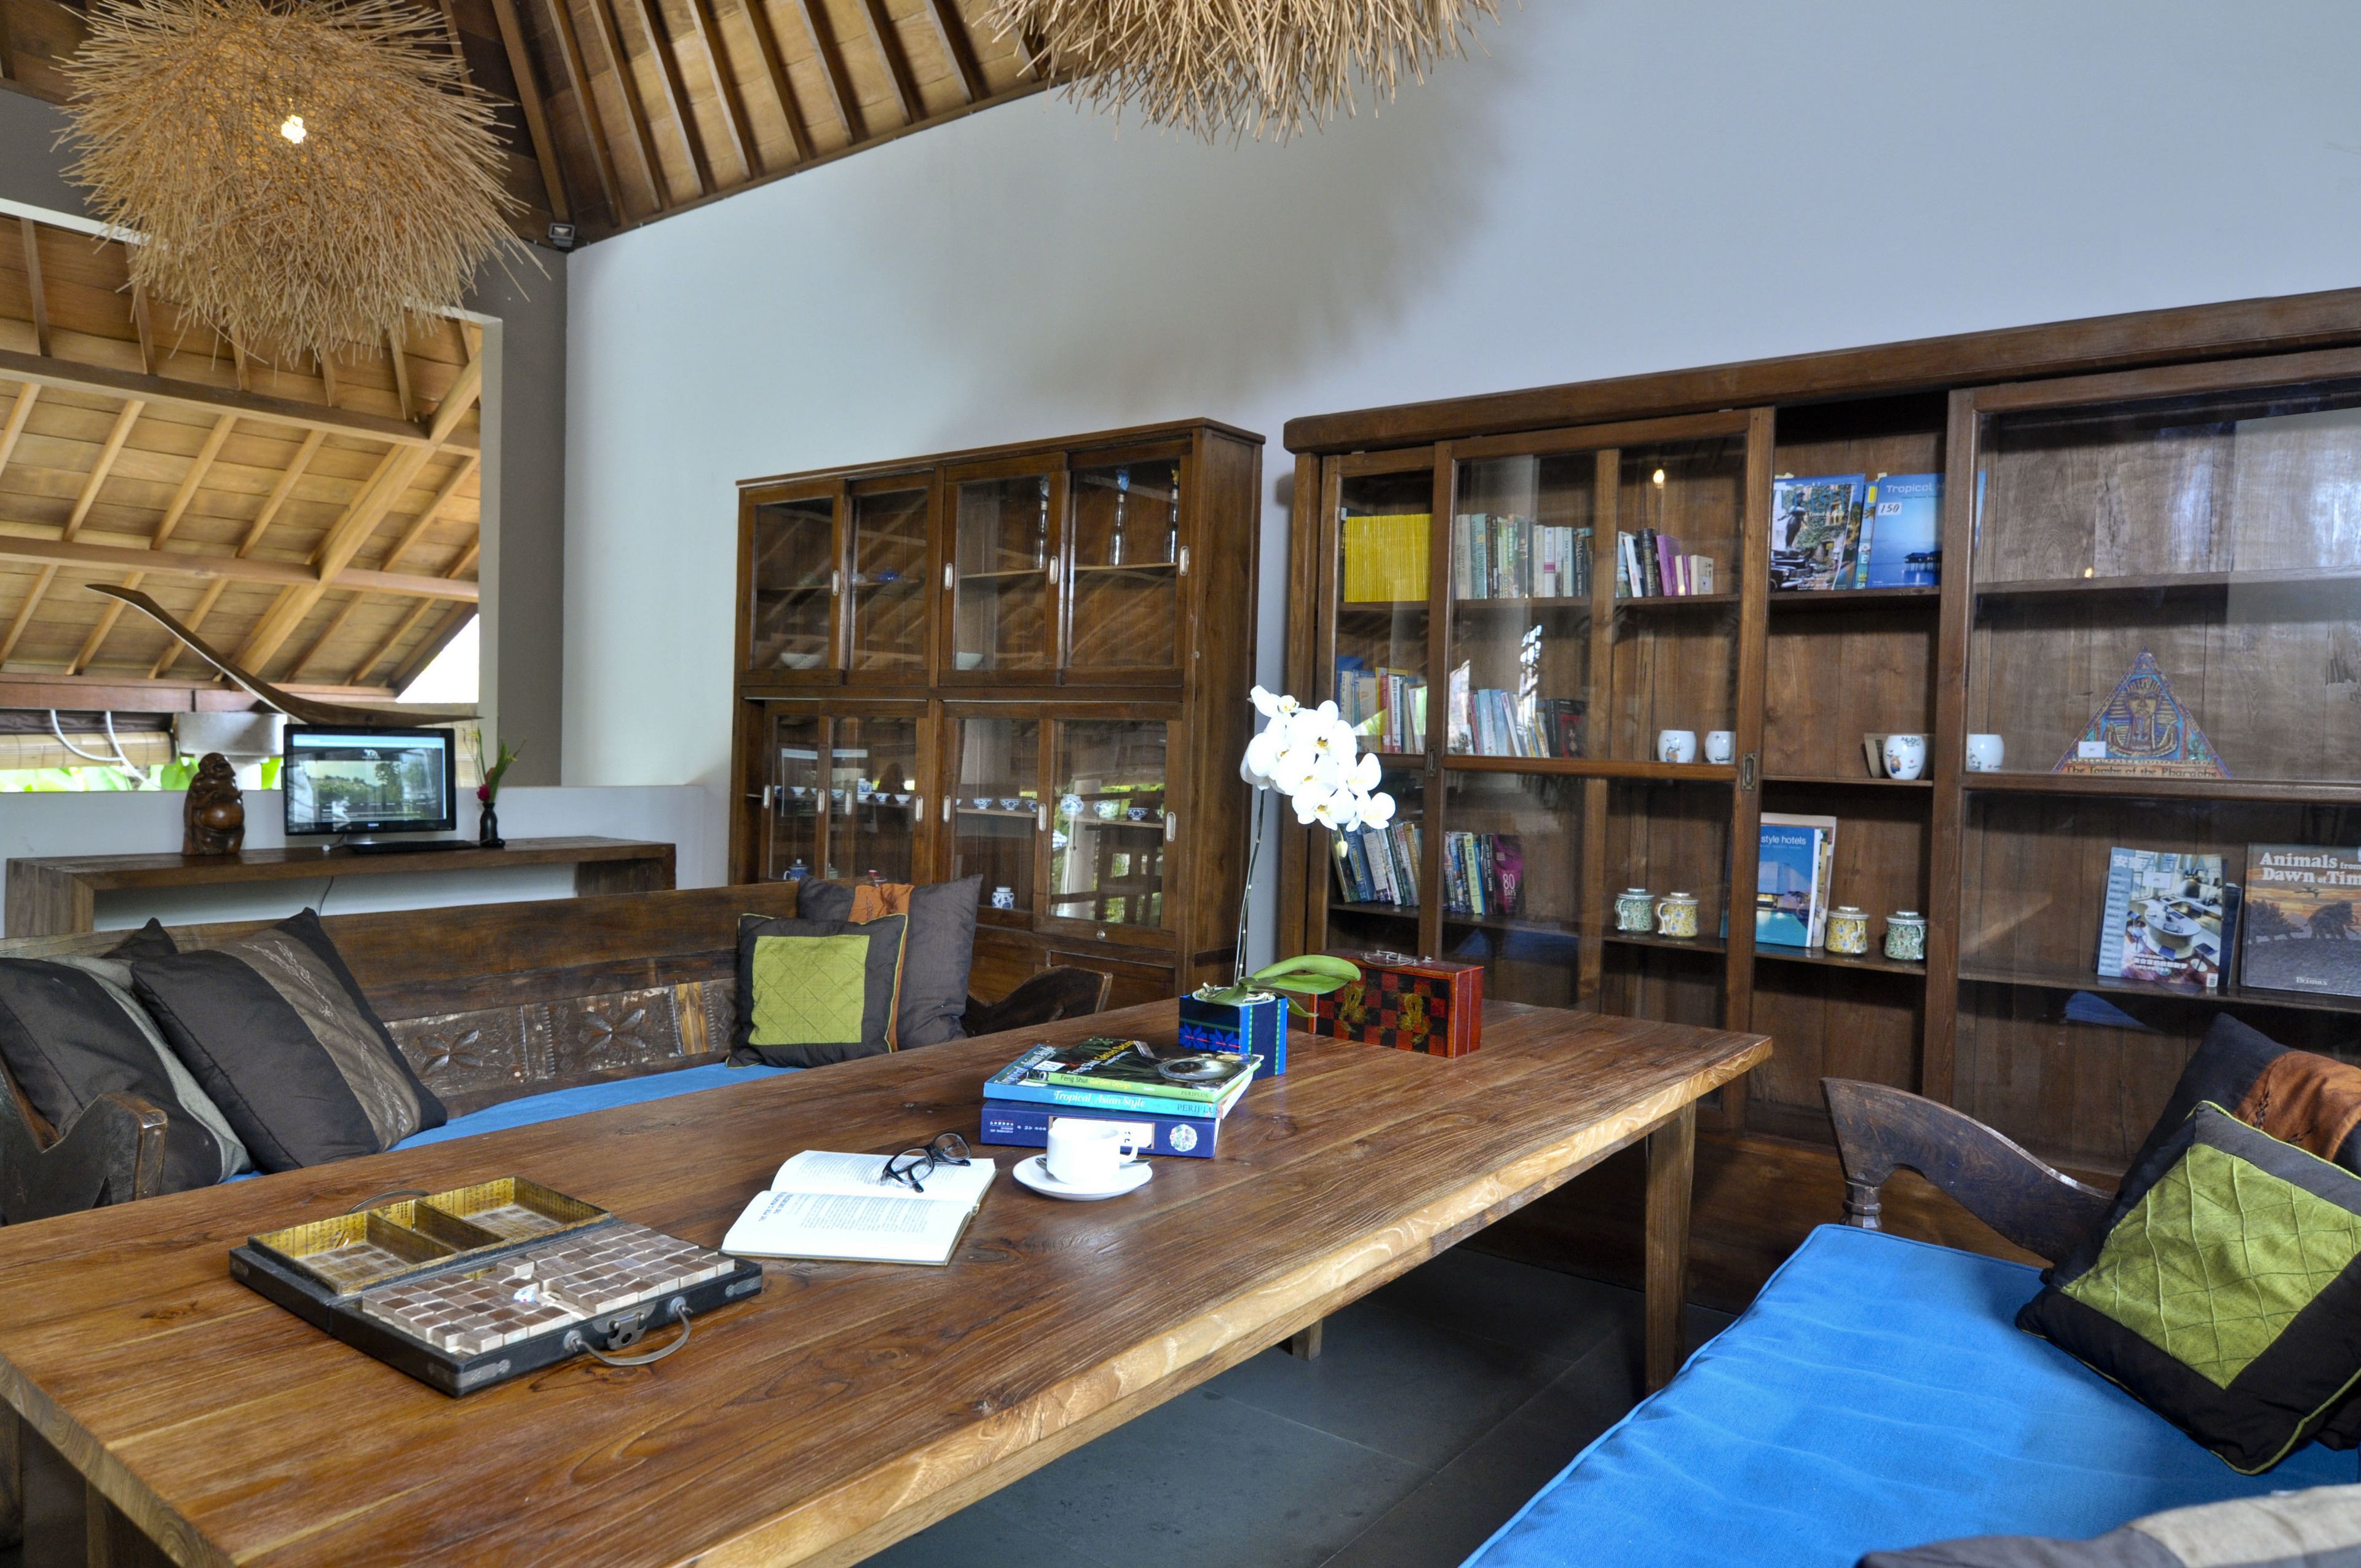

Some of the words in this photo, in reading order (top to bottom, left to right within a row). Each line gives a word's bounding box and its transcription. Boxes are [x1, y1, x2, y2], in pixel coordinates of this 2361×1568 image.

[1886, 482, 1933, 493] Tropical
[1880, 504, 1900, 513] 150
[2066, 766, 2085, 774] The
[2162, 767, 2217, 778] Pharaohs
[1761, 836, 1779, 845] style
[1781, 836, 1806, 845] hotels
[2259, 852, 2338, 868] Animals
[2339, 861, 2361, 870] from
[1503, 873, 1515, 889] 80
[2261, 867, 2316, 884] Dawn
[2327, 870, 2361, 886] Tim
[1060, 1074, 1075, 1083] Feng
[1054, 1090, 1092, 1103] Tropical
[1093, 1093, 1121, 1105] Asian
[1123, 1096, 1146, 1109] Style
[1177, 1104, 1220, 1114] PERIPLUS
